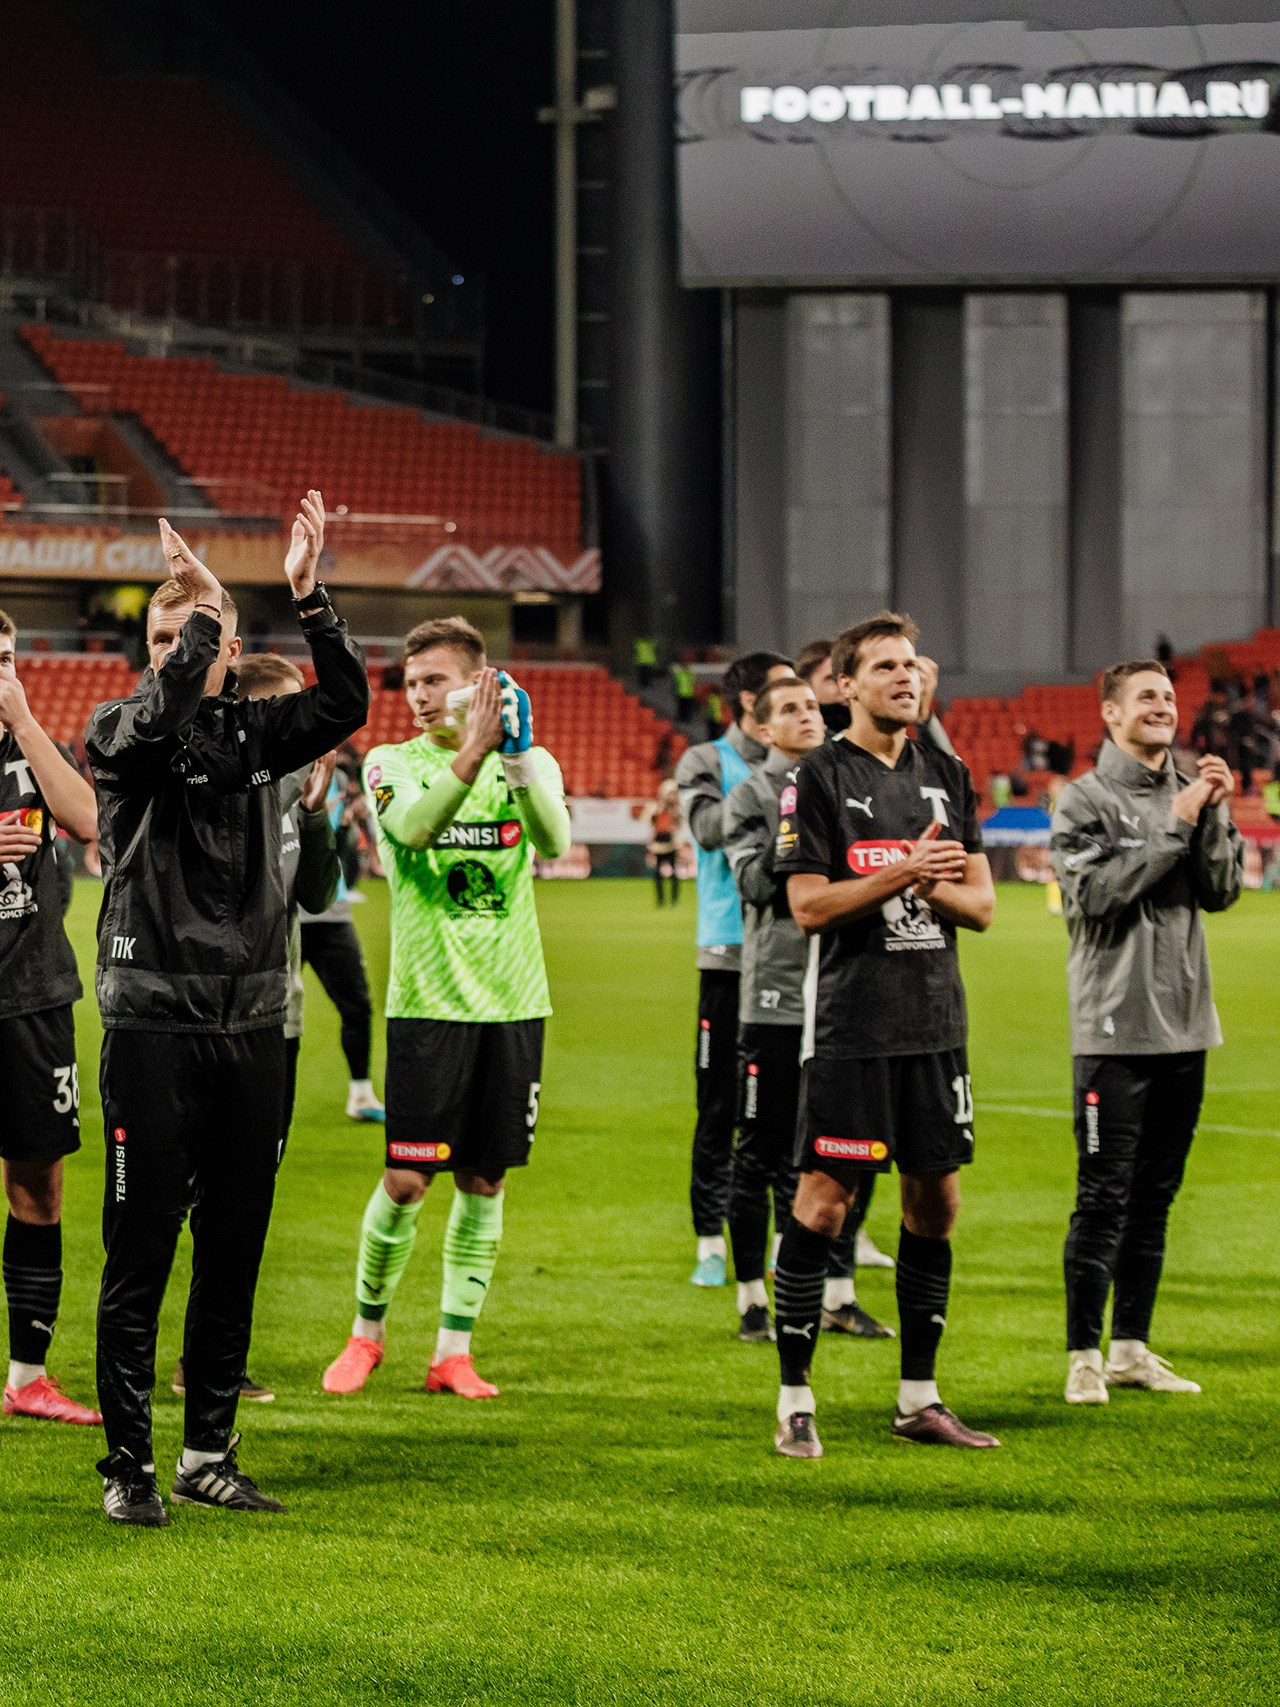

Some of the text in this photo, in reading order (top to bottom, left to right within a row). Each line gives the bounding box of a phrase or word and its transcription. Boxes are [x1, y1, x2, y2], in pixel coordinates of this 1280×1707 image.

[739, 79, 1270, 123] FOOTBALL-MANIA.RU
[437, 826, 499, 846] ENNISI
[111, 935, 137, 960] ПК
[52, 1062, 81, 1114] 38
[525, 1082, 541, 1128] 5
[390, 1142, 435, 1158] TENNISI
[819, 1138, 870, 1157] TENNISI
[116, 1144, 126, 1203] TENNISI
